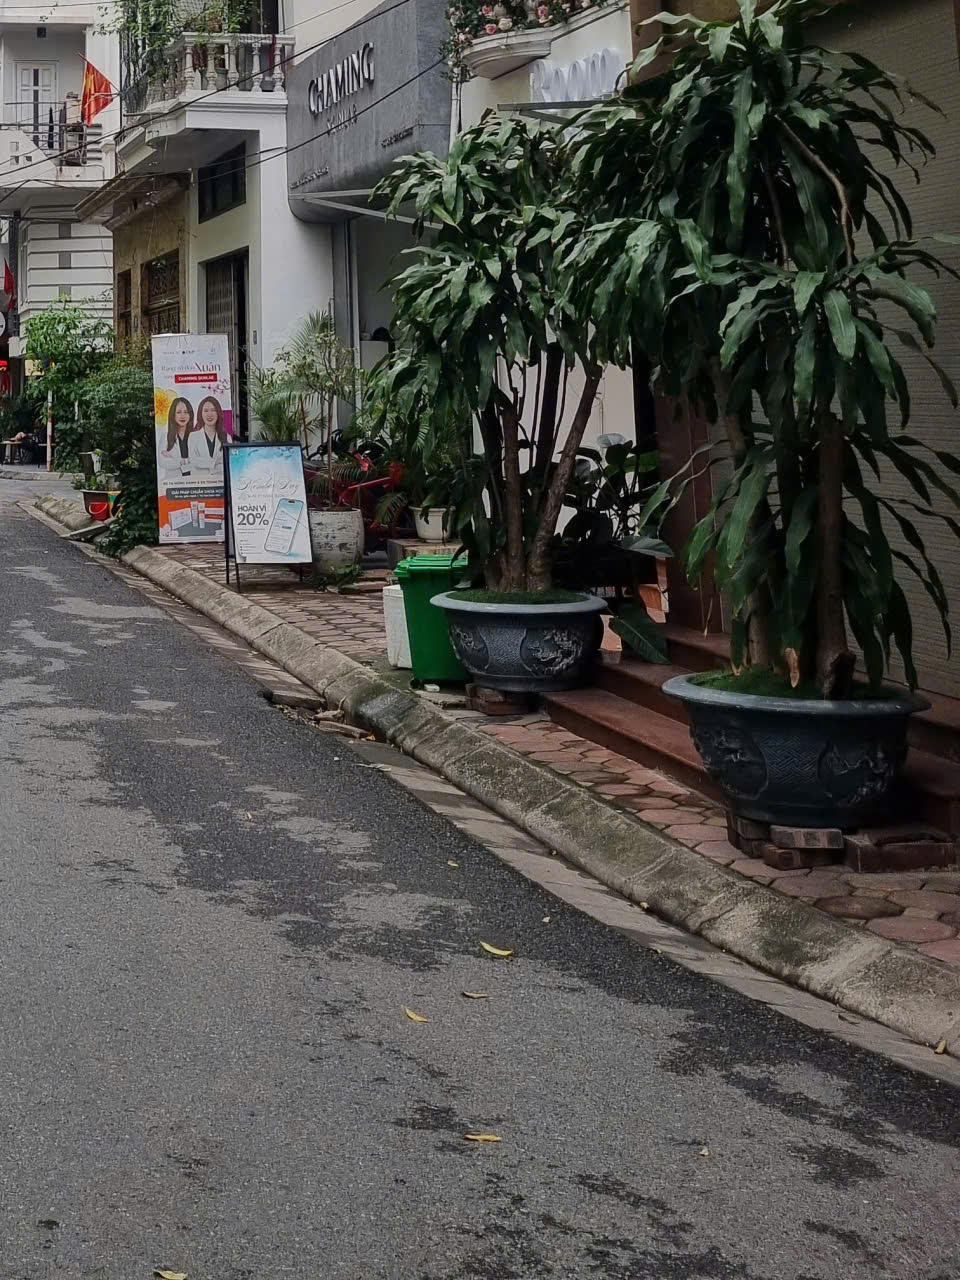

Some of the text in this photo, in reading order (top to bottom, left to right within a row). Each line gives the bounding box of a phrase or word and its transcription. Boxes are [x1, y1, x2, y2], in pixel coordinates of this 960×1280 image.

[308, 42, 375, 115] CHAMING
[237, 503, 259, 512] HOÀN
[237, 512, 269, 526] 20%
